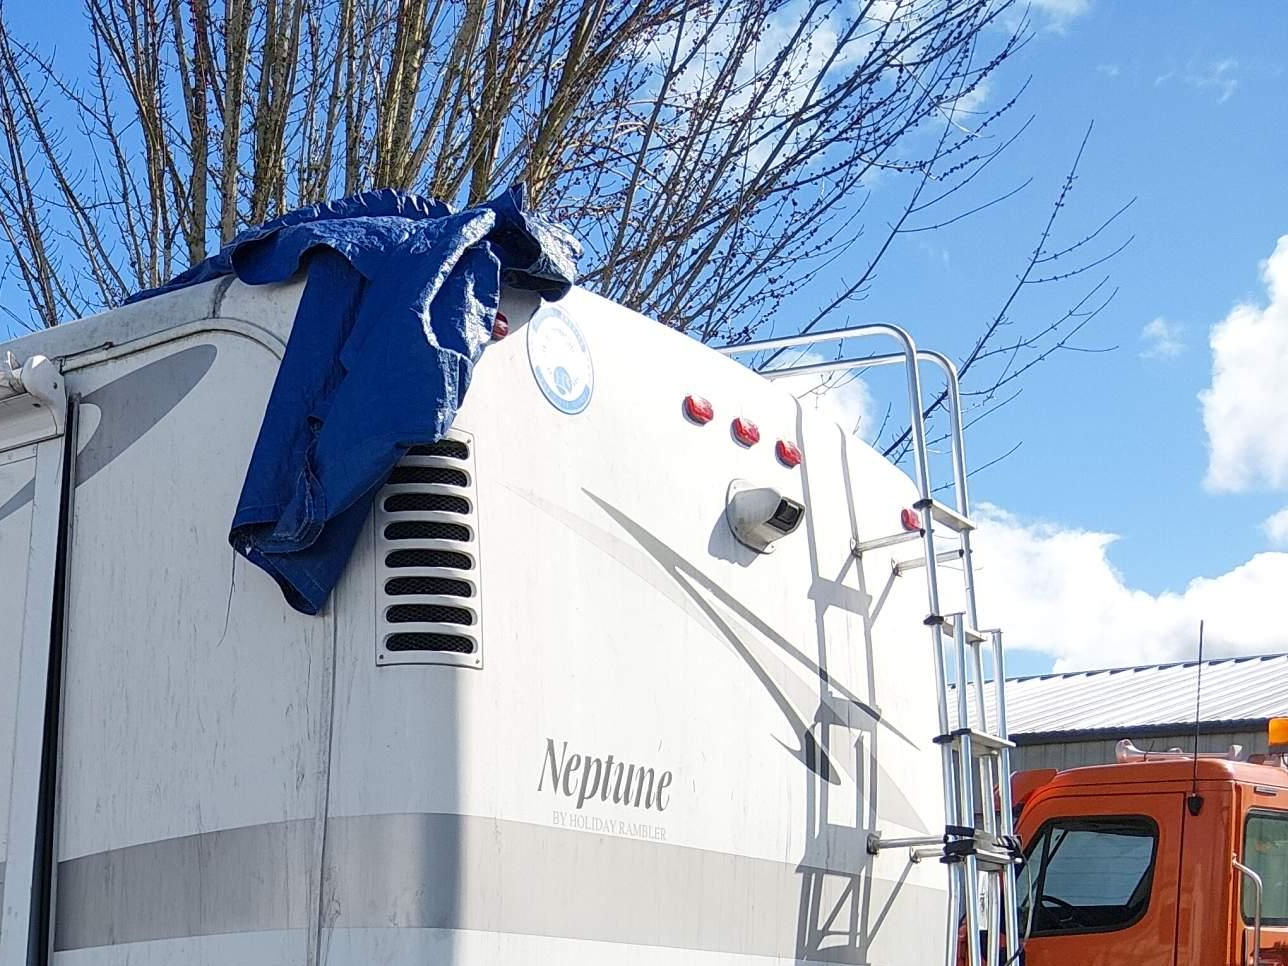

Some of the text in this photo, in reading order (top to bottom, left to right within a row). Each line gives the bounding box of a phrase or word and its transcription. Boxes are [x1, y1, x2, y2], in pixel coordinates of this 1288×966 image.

[537, 737, 673, 812] Neptune
[552, 810, 667, 841] BY HOLIDAY RAMBLER
